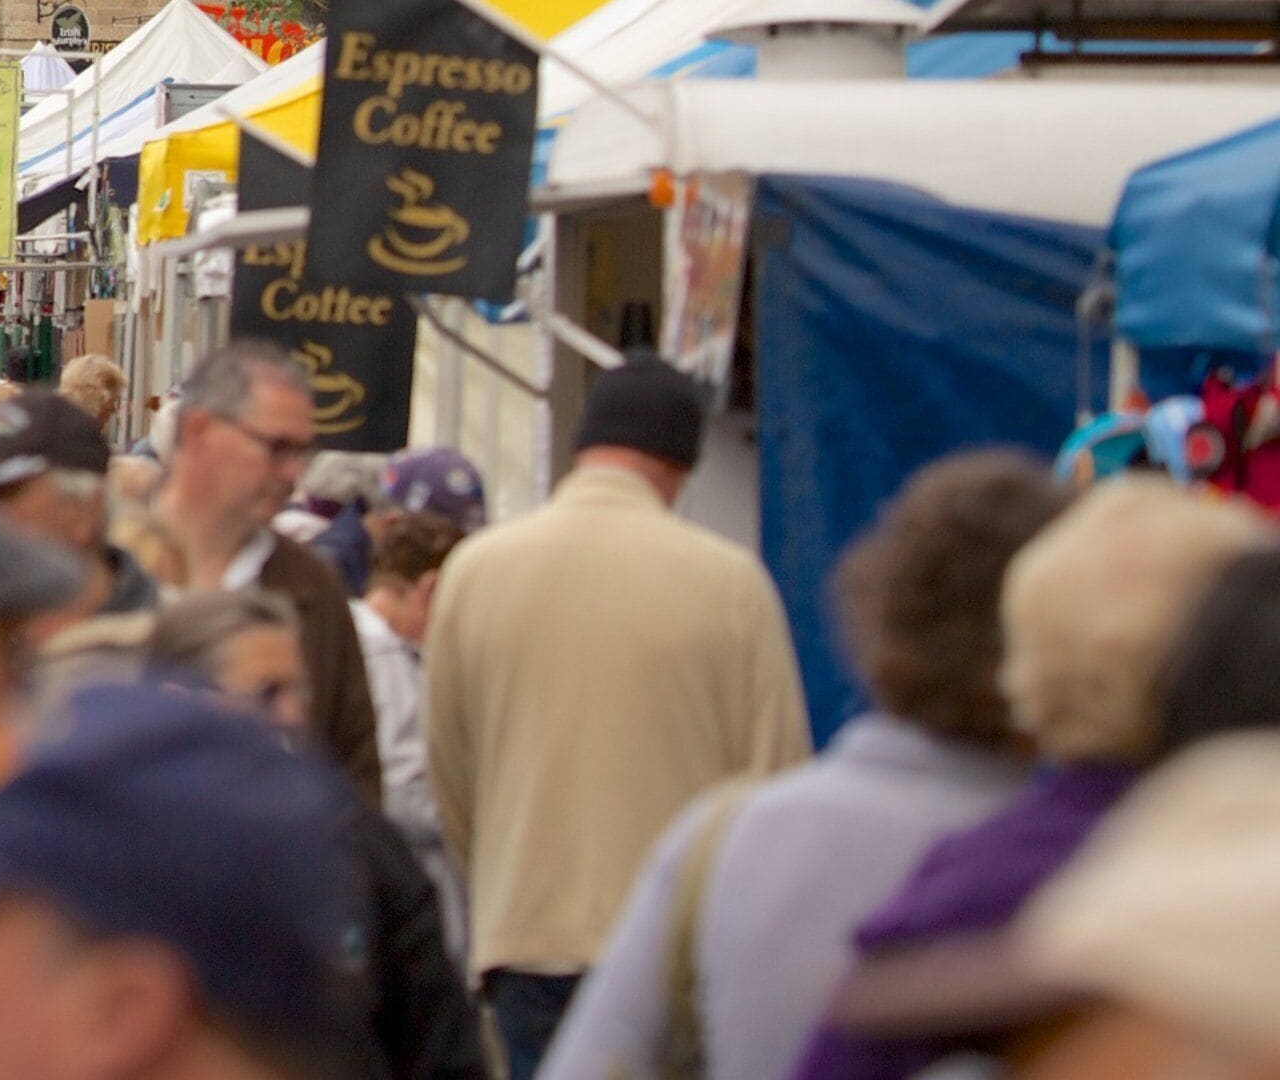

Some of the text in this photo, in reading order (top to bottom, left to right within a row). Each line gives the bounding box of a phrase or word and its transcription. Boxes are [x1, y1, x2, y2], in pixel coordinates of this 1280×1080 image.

[59, 27, 81, 37] Irish
[337, 30, 533, 98] Espresso
[352, 94, 502, 154] Coffee
